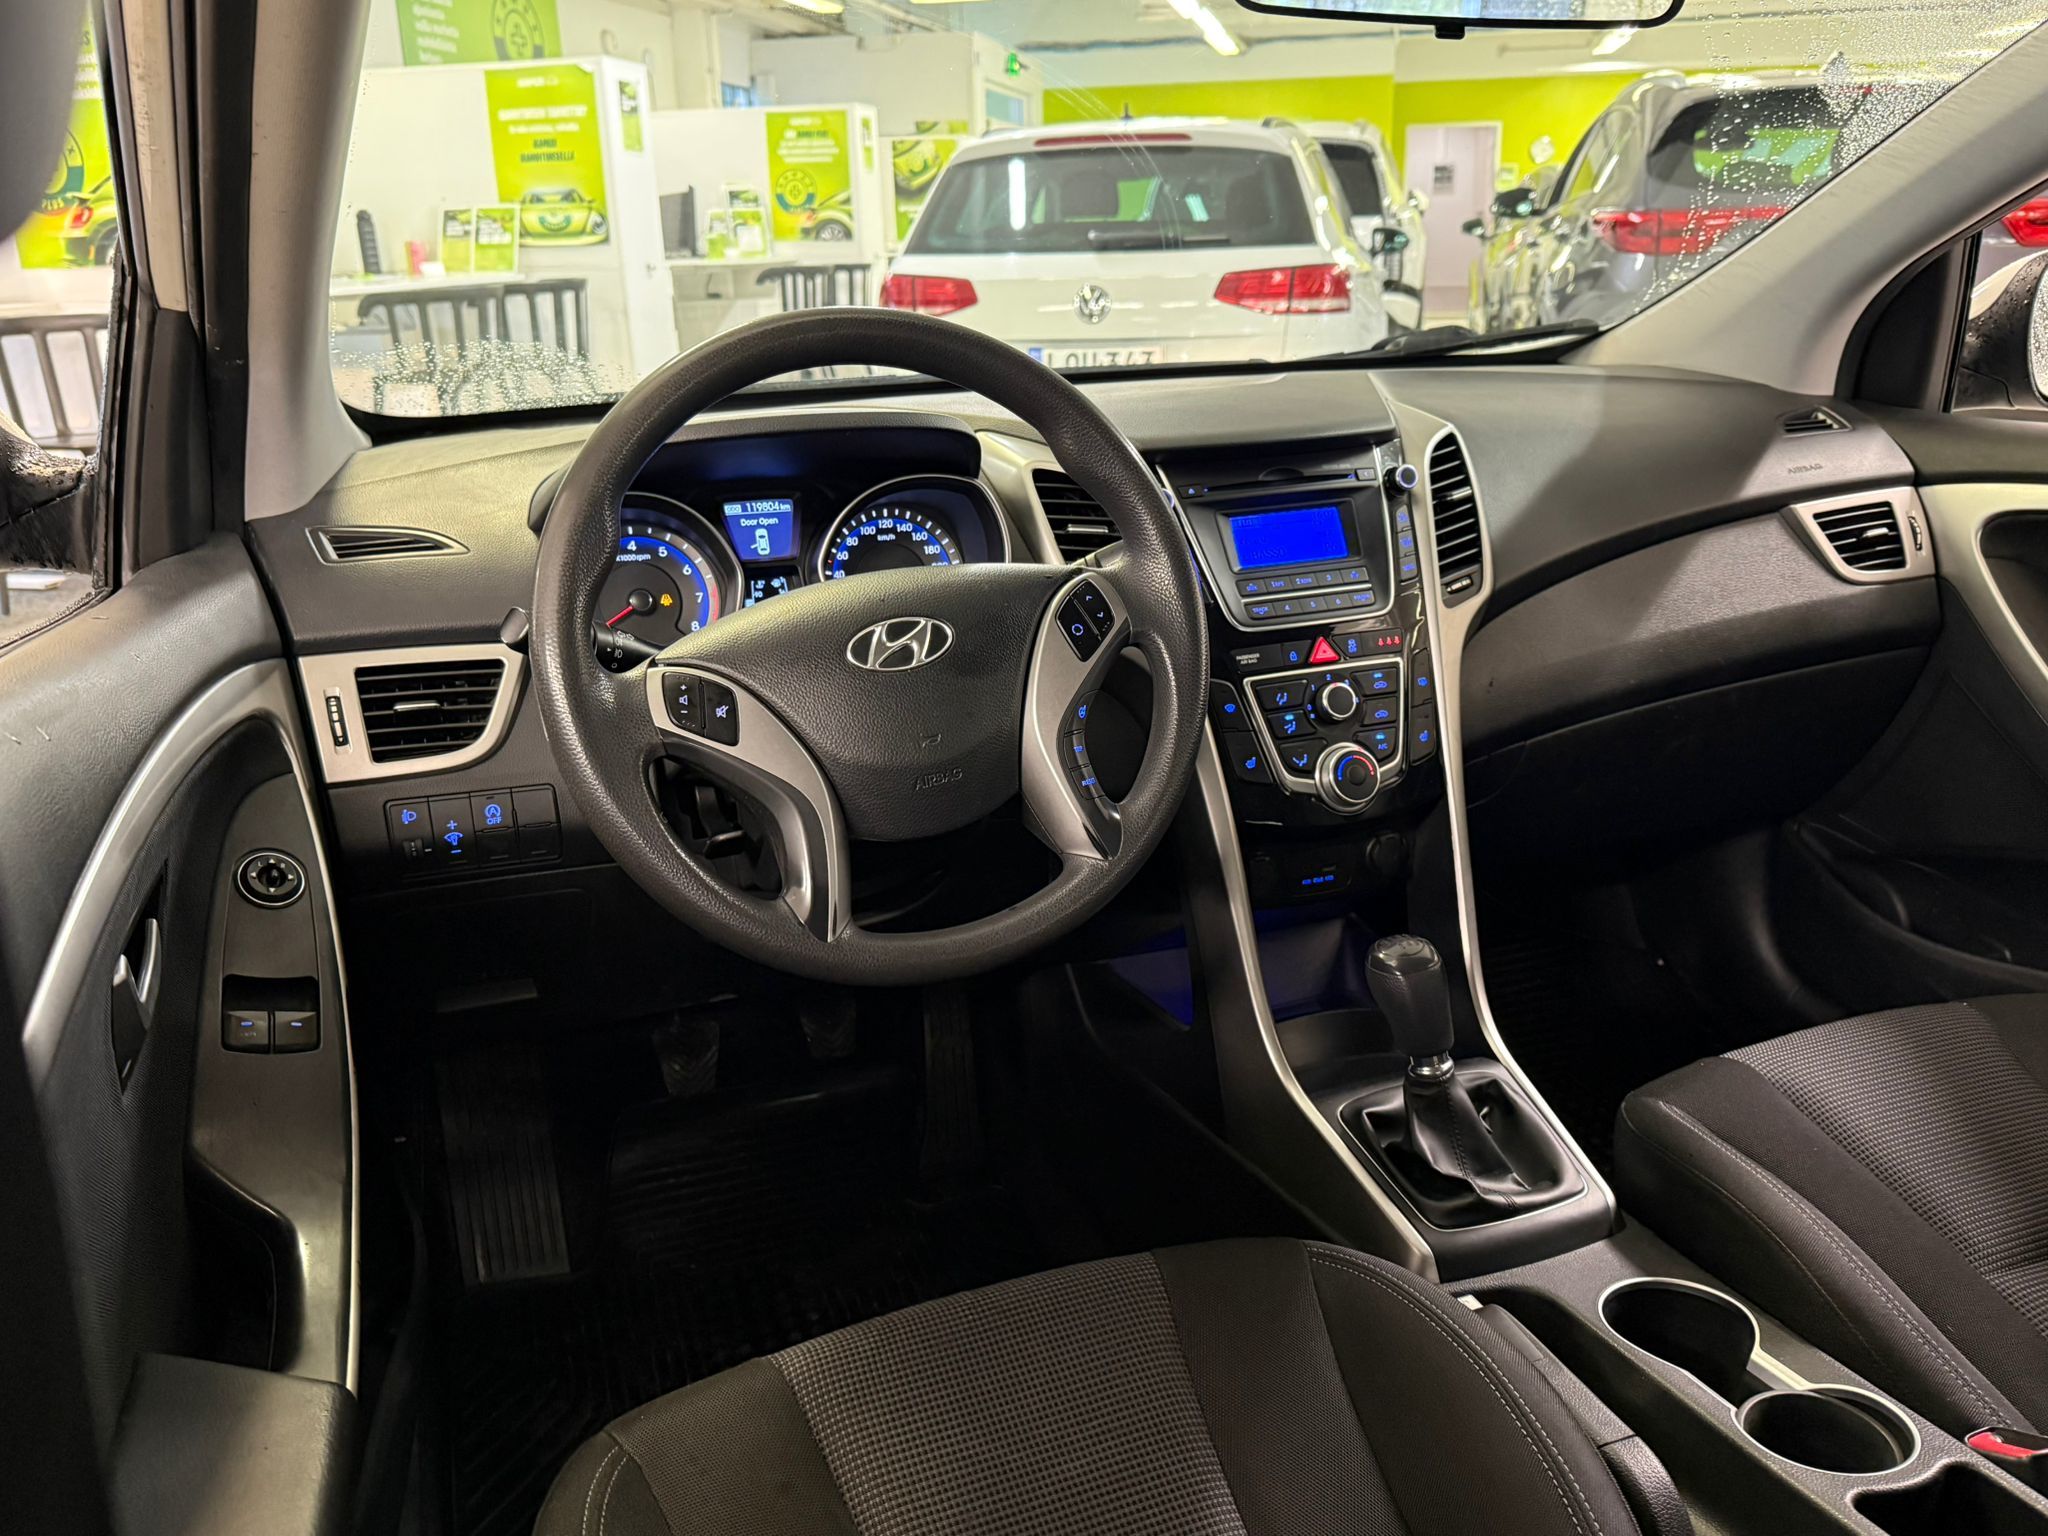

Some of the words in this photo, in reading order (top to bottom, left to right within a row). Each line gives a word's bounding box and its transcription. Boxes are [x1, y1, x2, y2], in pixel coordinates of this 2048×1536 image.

[1787, 463, 1823, 475] AIRBAG
[740, 518, 758, 526] Door
[759, 517, 779, 526] Open
[878, 520, 894, 529] 120
[860, 526, 876, 535] 100
[896, 523, 913, 532] 140
[877, 533, 896, 541] km/h
[912, 531, 928, 541] 160
[627, 540, 637, 551] 4
[846, 537, 859, 546] 80
[658, 546, 668, 557] 5
[924, 545, 941, 554] 180
[837, 551, 849, 560] 60
[682, 564, 692, 575] 6
[833, 570, 846, 579] 40
[695, 592, 704, 603] 7
[691, 621, 700, 632] 8
[914, 767, 963, 791] AIRBAG
[487, 816, 502, 825] OFF
